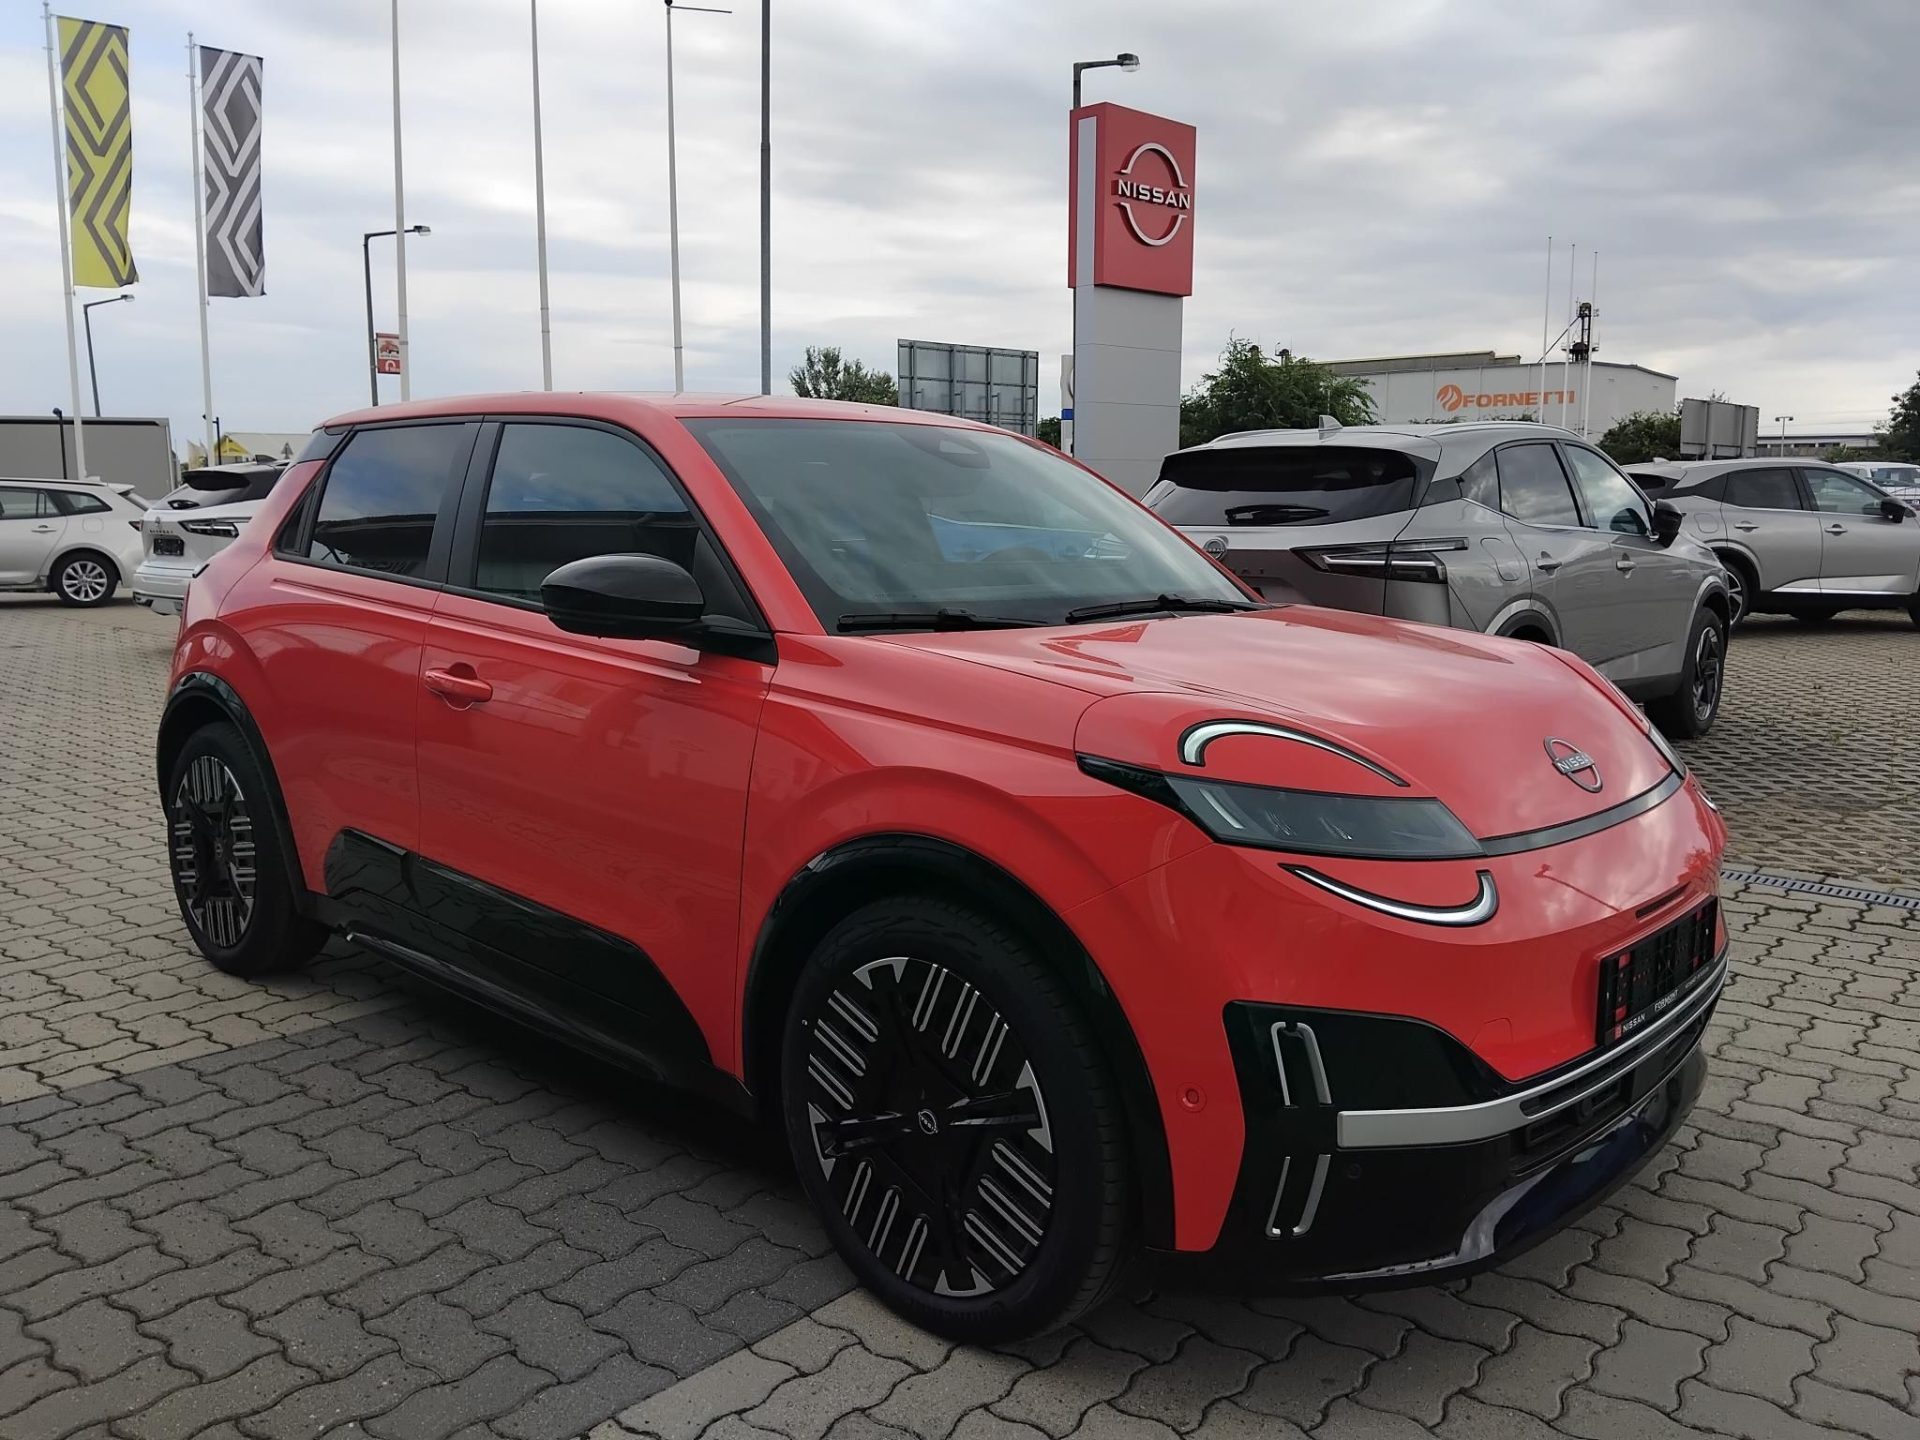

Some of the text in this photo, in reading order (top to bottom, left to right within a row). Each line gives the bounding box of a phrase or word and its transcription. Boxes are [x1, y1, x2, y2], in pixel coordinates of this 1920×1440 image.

[1117, 179, 1191, 209] NISSAN
[1462, 390, 1576, 408] FORNETTI
[1623, 1013, 1646, 1033] NISSAN
